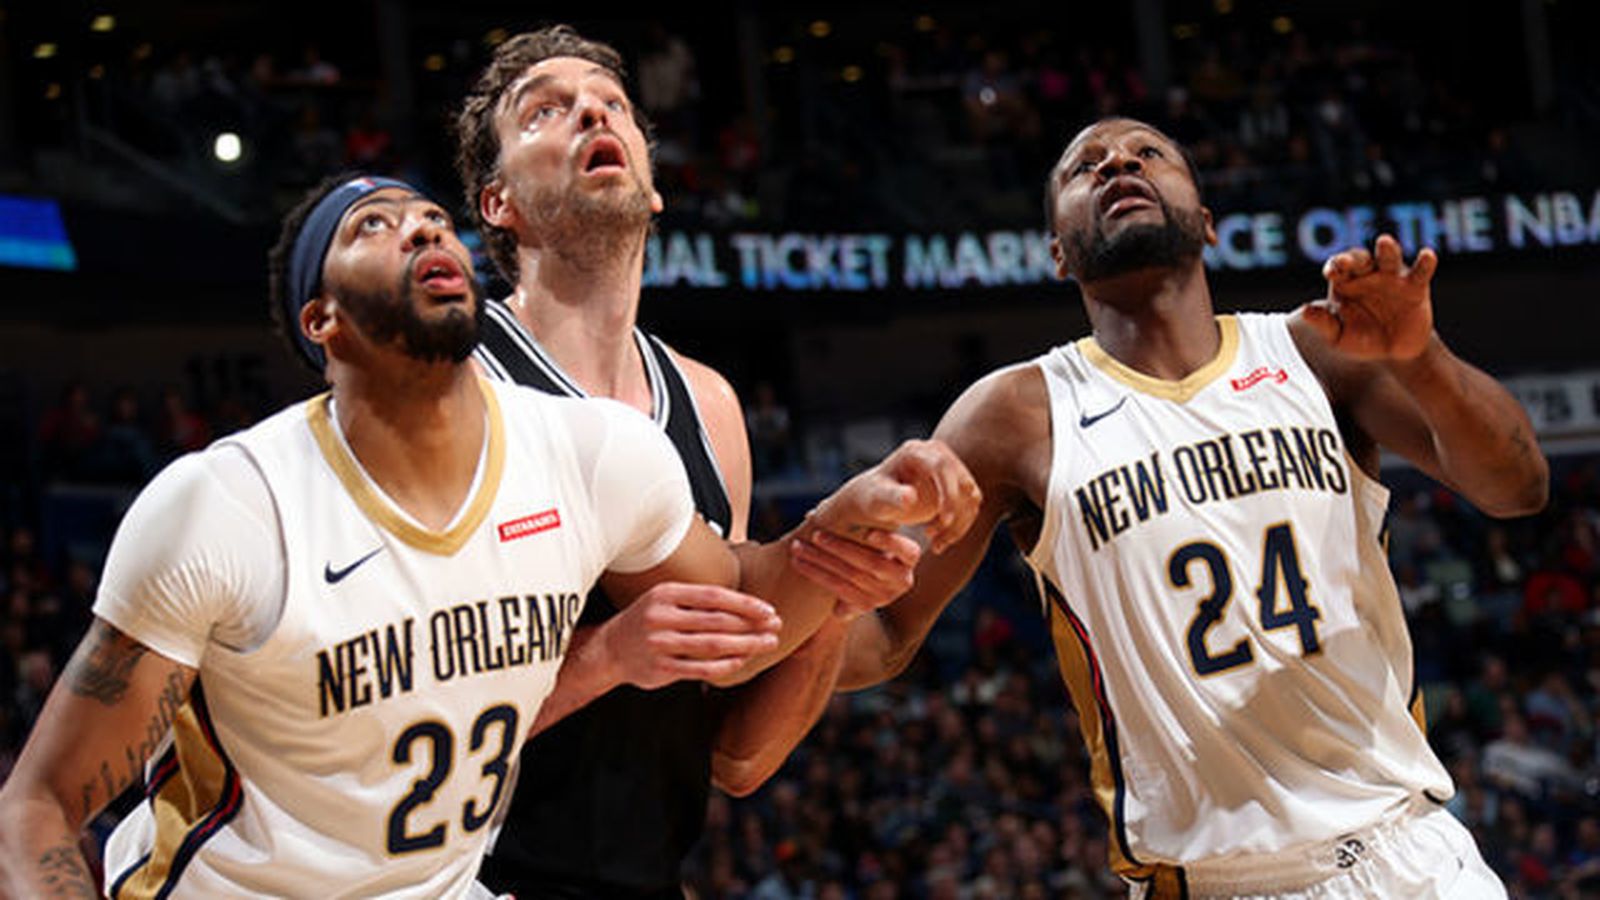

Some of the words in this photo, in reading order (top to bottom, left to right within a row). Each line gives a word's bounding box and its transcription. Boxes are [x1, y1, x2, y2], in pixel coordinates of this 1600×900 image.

[641, 230, 727, 287] IAL
[731, 234, 892, 290] TICKET
[1296, 205, 1376, 262] OF
[1387, 198, 1493, 256] THE
[1075, 452, 1169, 551] NEW
[1173, 426, 1348, 506] ORLEANS
[316, 616, 415, 718] NEW
[430, 592, 580, 681] ORLEANS
[1167, 521, 1323, 679] 24
[384, 702, 519, 857] 23
